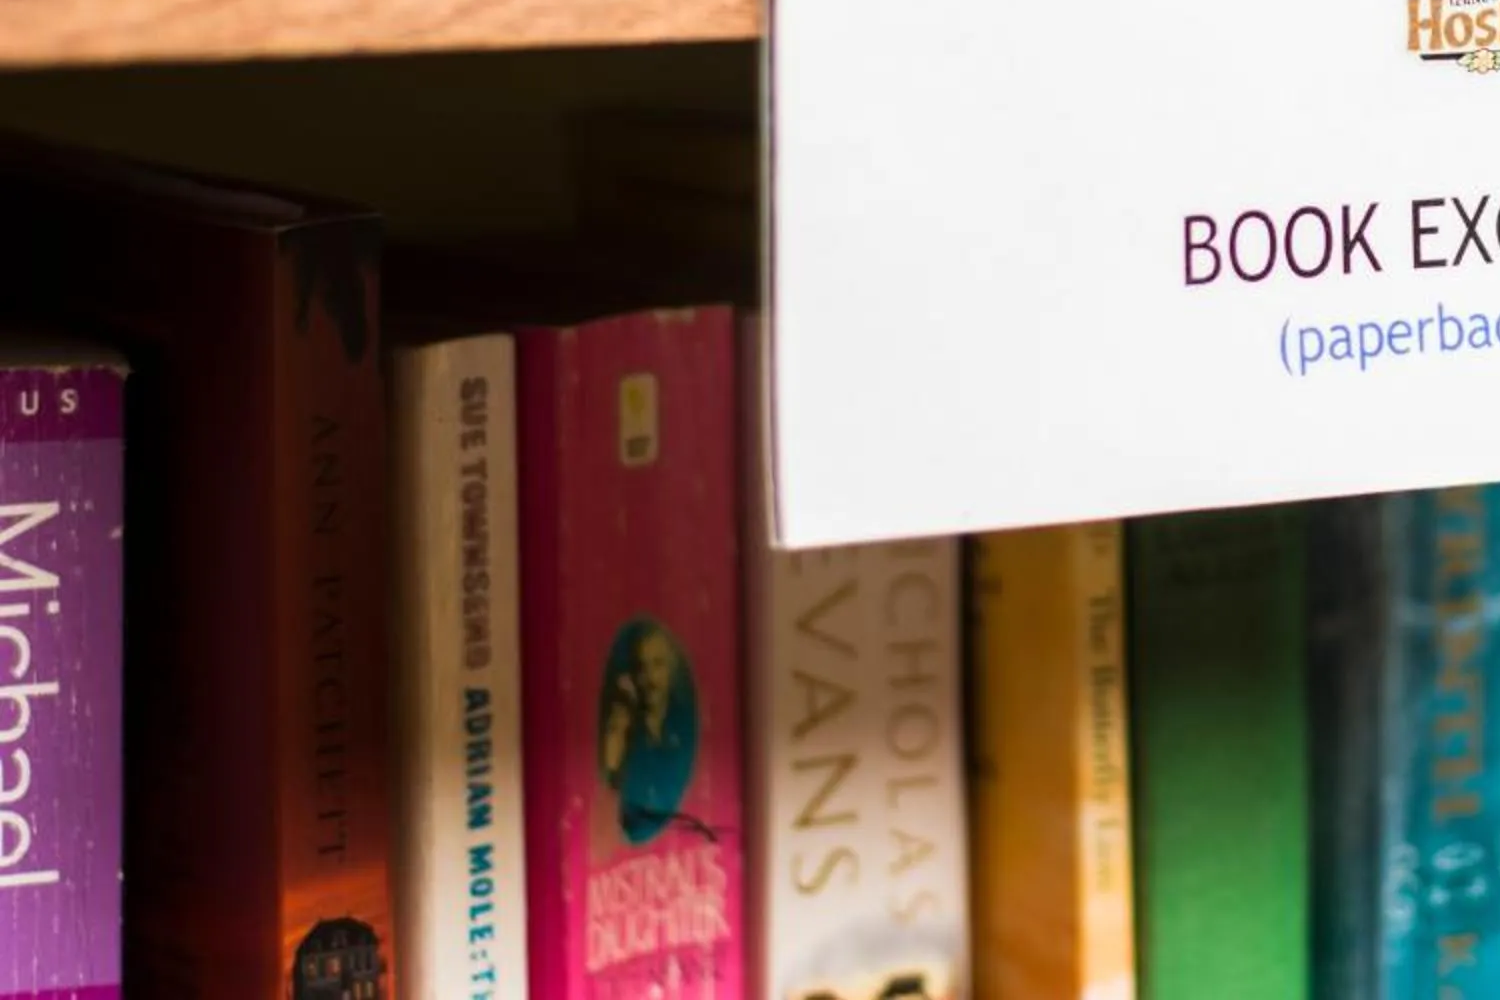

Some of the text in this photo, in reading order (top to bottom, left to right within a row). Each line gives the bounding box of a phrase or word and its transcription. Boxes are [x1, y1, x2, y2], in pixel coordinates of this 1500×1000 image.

[1183, 202, 1383, 286] BOOK
[459, 376, 490, 450] SUE
[310, 413, 351, 865] ANN PATCHETT
[460, 456, 493, 671] TOWNSEND
[0, 500, 60, 887] Michael
[463, 687, 494, 830] ADRIAN
[884, 541, 941, 925] ICHOLAS
